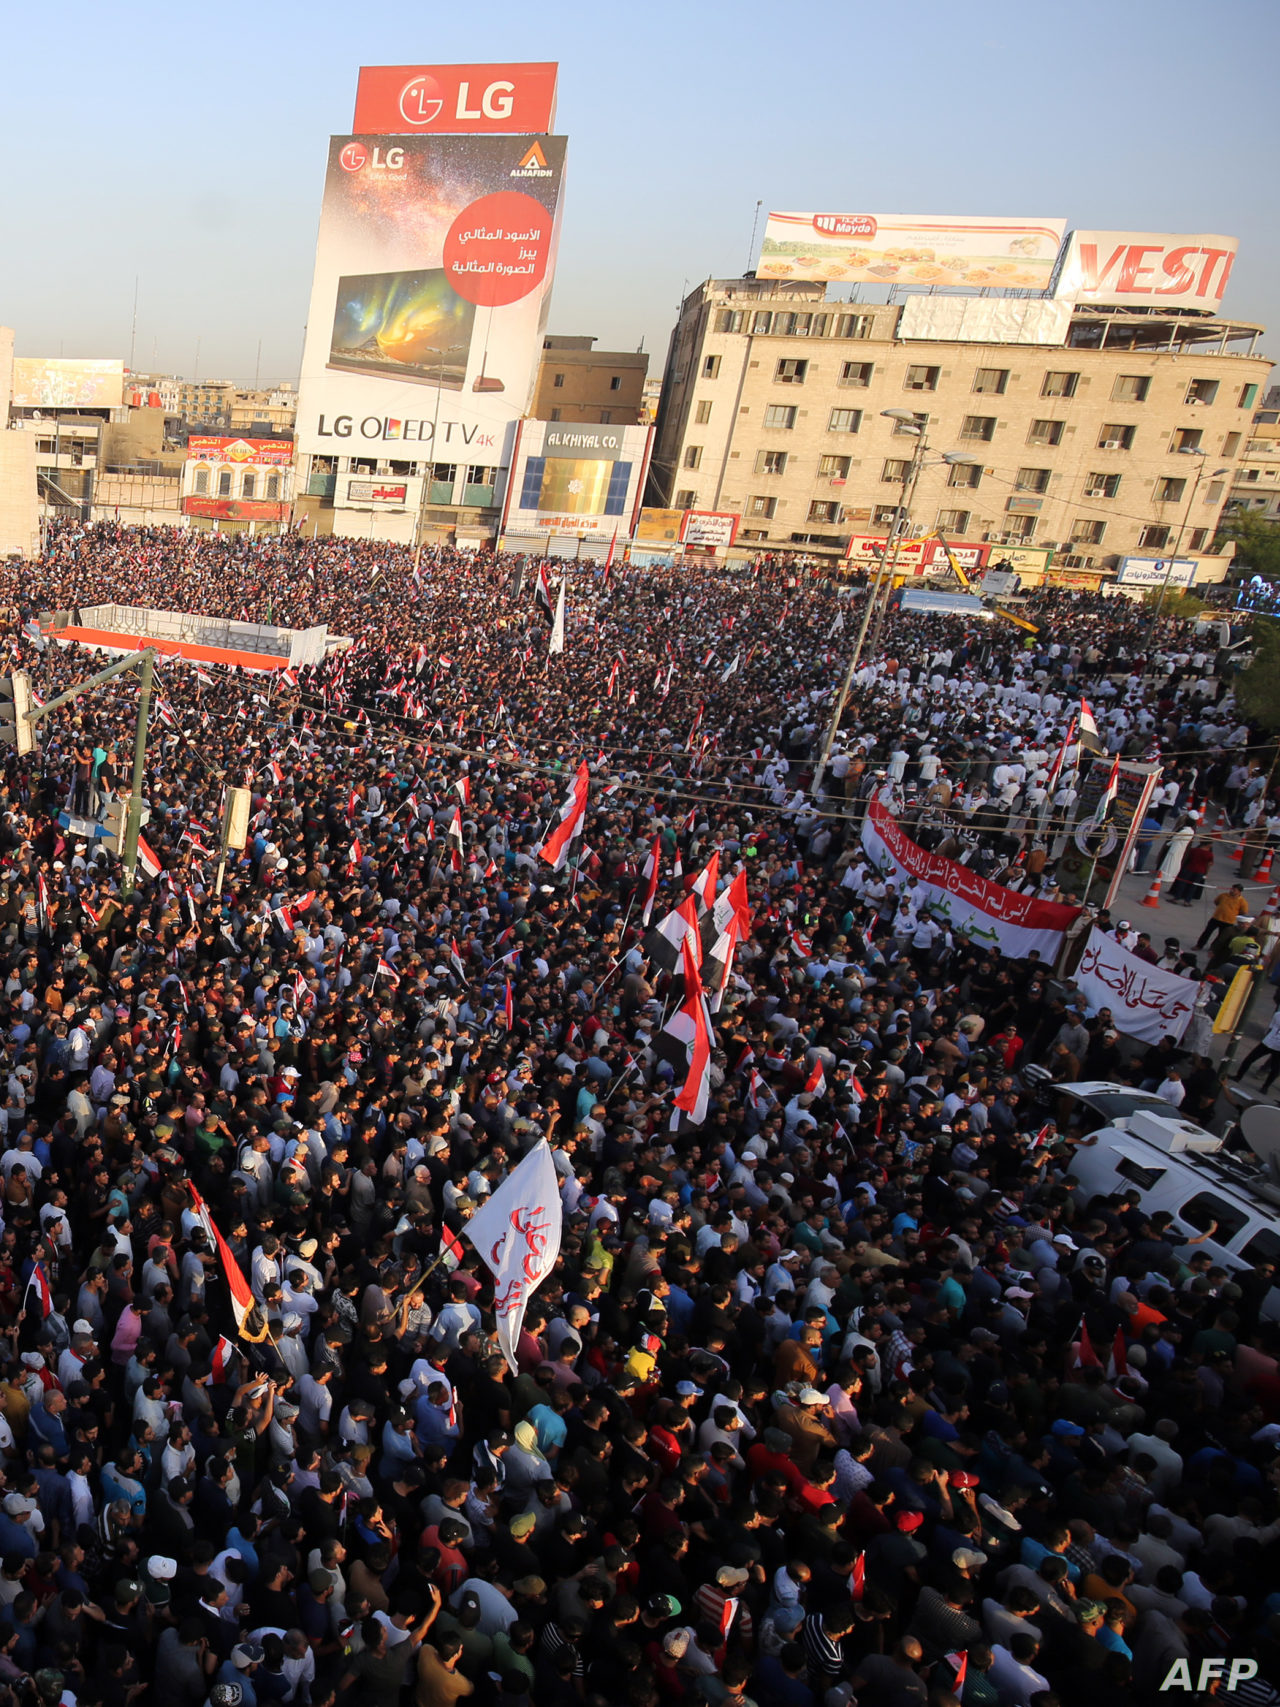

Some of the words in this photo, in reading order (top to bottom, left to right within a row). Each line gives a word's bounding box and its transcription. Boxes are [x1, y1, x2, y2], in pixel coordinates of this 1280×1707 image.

[455, 81, 515, 119] LG
[371, 147, 405, 169] LG
[510, 169, 553, 178] ALHAFIDH
[458, 227, 503, 244] المثالي
[503, 229, 540, 242] الأسود
[835, 222, 871, 235] Mayda
[451, 260, 494, 275] المثالية
[495, 263, 534, 276] الصورة
[317, 413, 353, 438] LG
[360, 416, 435, 441] OLED
[441, 421, 480, 445] TV
[476, 433, 496, 447] 4K
[547, 432, 561, 446] AL
[562, 433, 599, 448] KHIYAL
[602, 435, 619, 449] CO.
[984, 892, 1006, 910] لم
[1125, 978, 1168, 1008] على
[1159, 1001, 1191, 1030] حي
